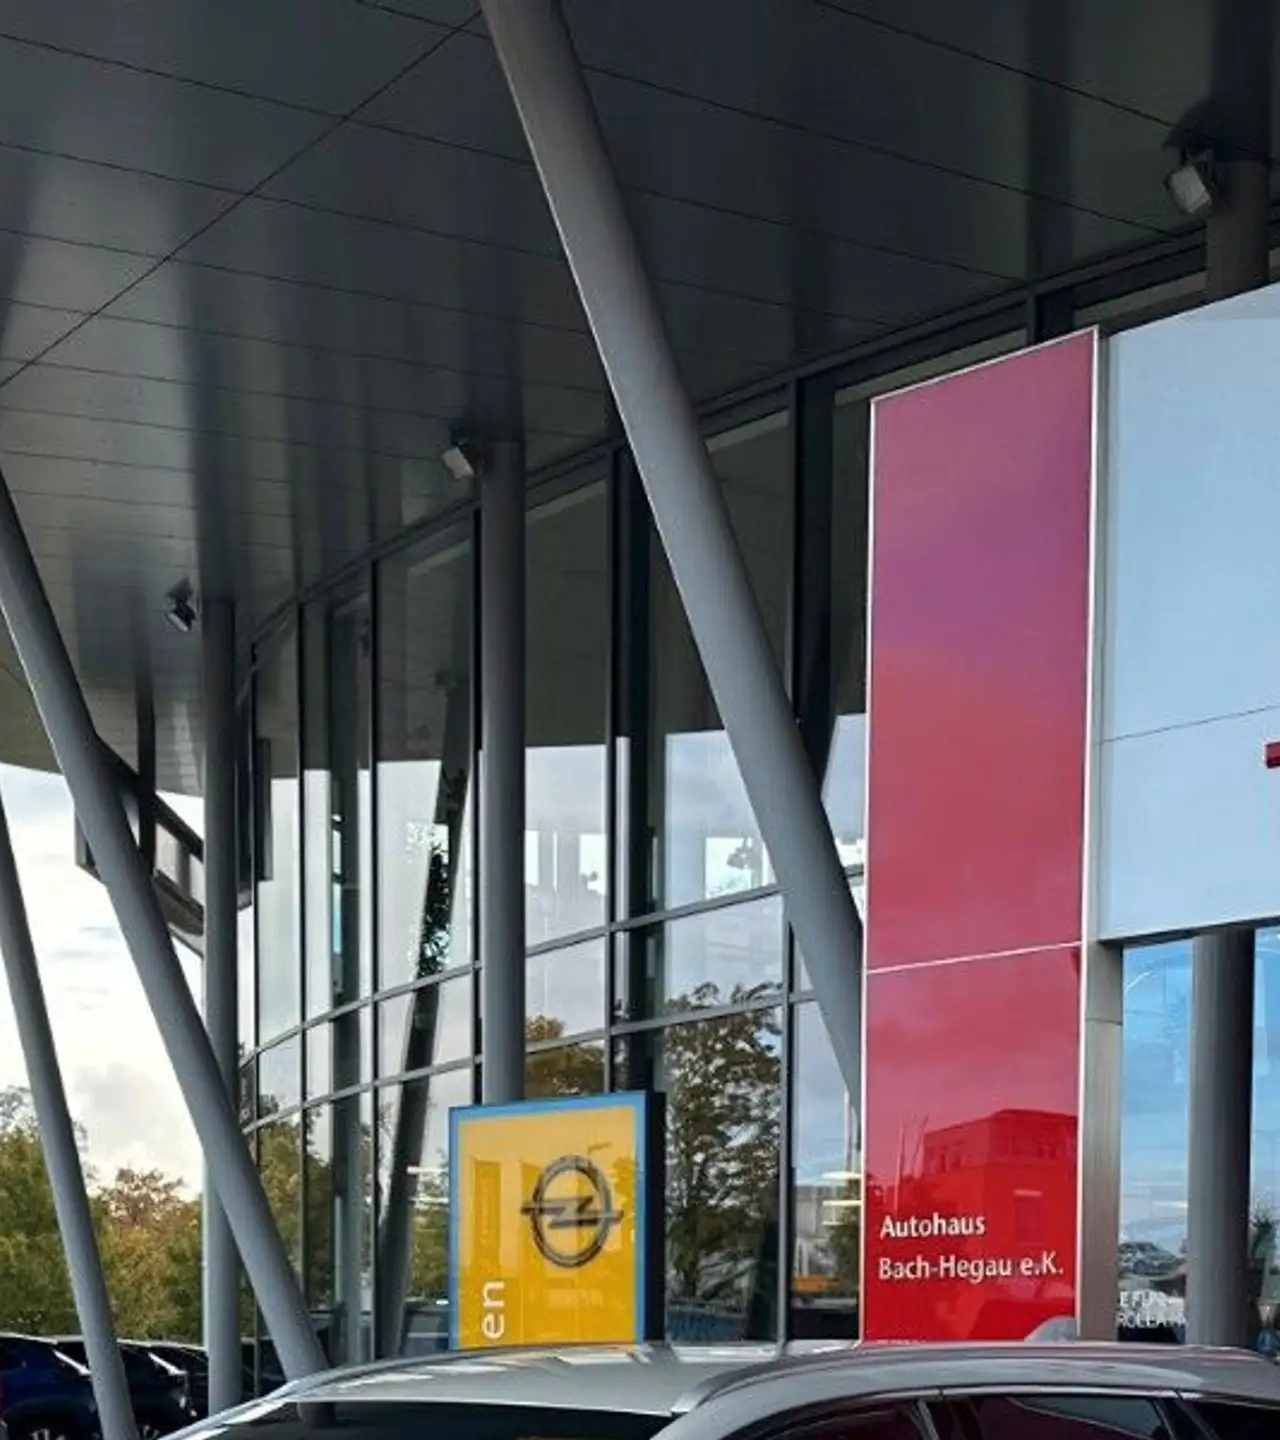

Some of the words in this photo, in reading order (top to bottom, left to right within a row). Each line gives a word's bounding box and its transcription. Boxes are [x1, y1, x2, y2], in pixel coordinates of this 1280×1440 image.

[880, 1211, 986, 1239] Autohaus
[878, 1253, 1012, 1284] Bach-Hegau
[1020, 1250, 1064, 1277] e.K.
